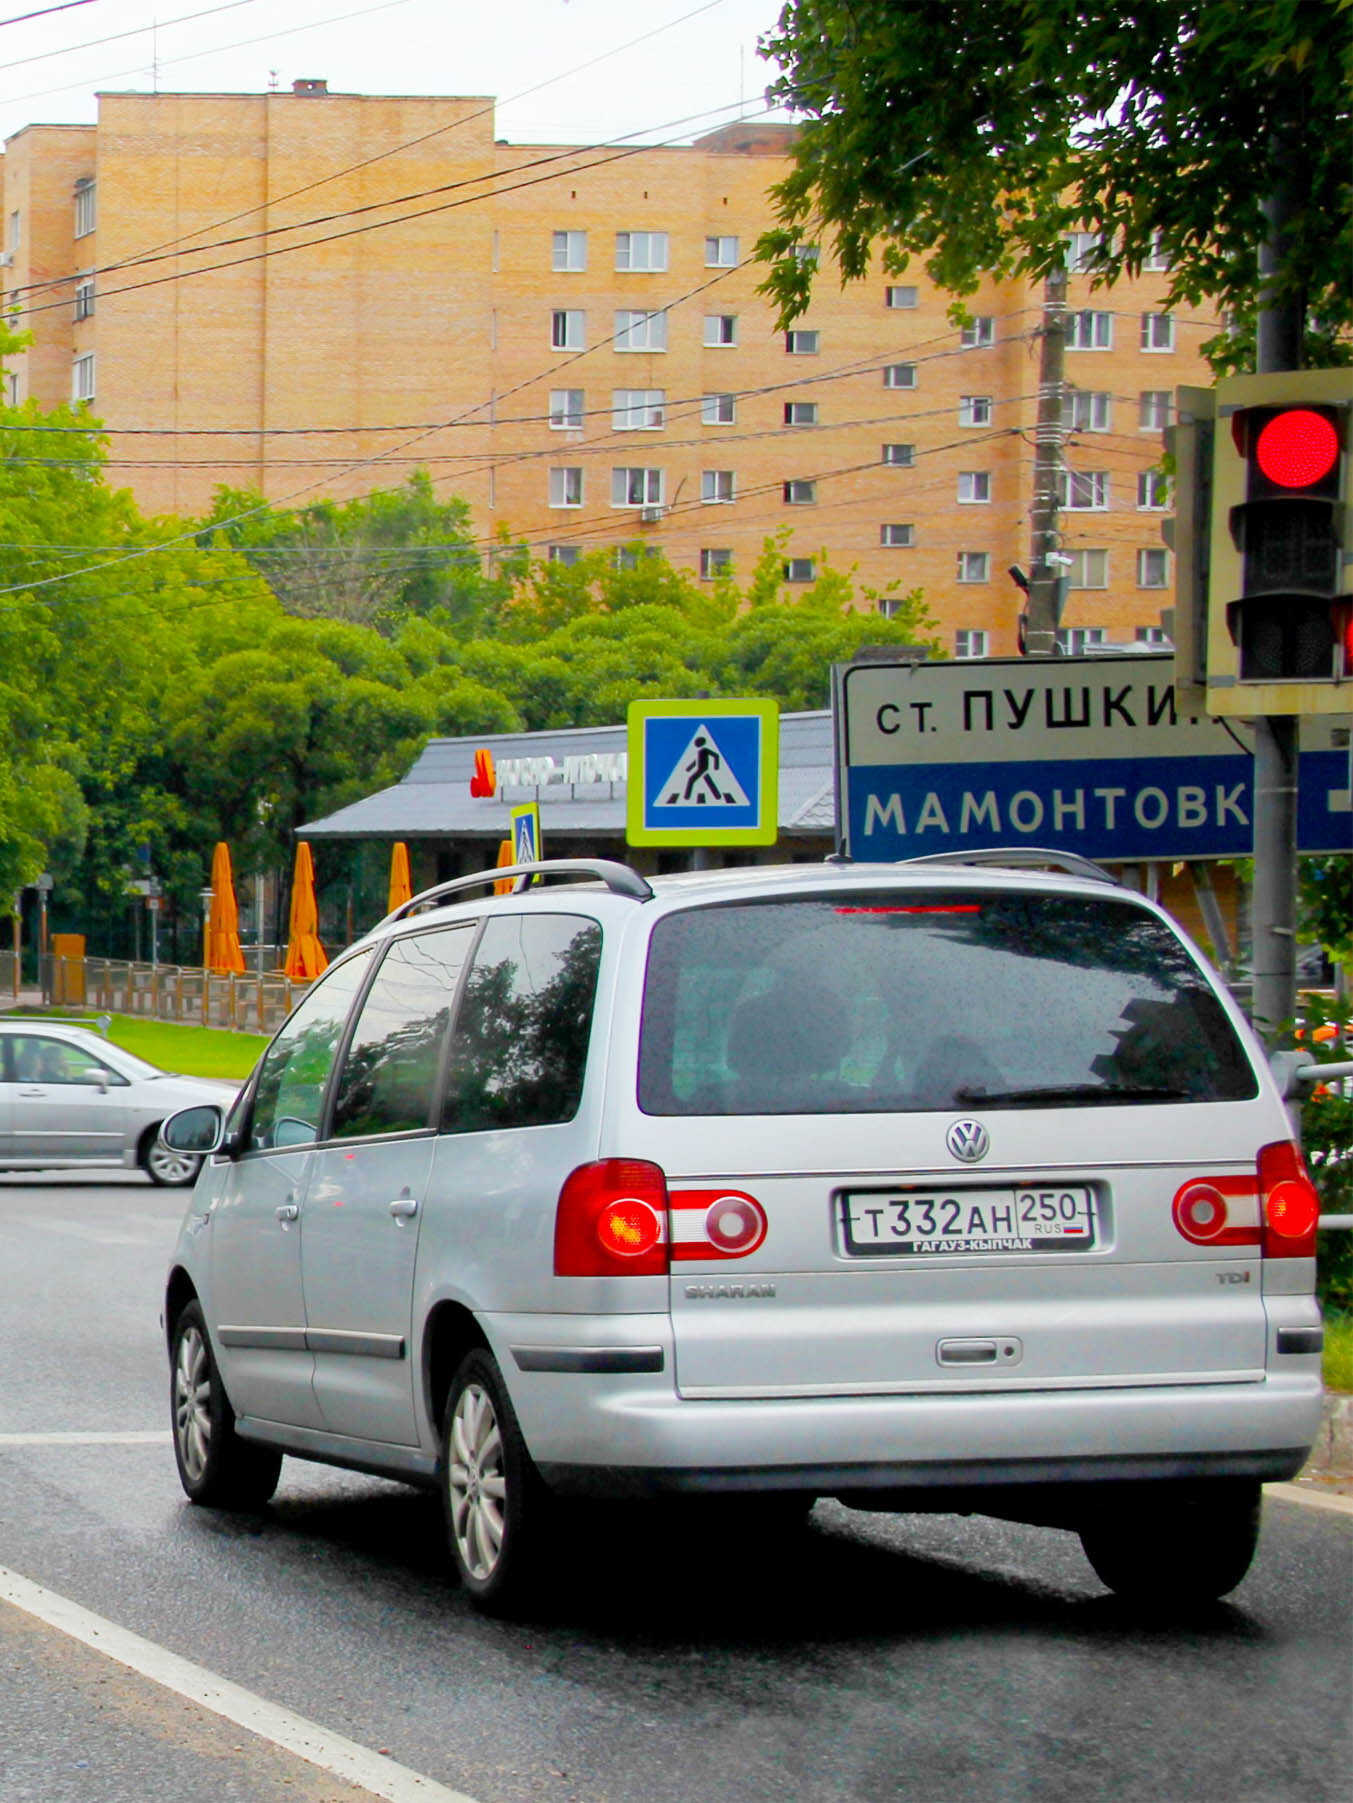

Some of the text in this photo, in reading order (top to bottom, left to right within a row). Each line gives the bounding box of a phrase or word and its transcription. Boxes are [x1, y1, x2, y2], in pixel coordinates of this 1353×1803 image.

[963, 684, 1218, 731] ПУШКИ
[864, 782, 1250, 836] МАМОНТОВК
[1034, 1223, 1062, 1235] RUS
[913, 1237, 1033, 1253] ГАГАУЗ-КЫПЧАК
[684, 1283, 777, 1299] SHARAN
